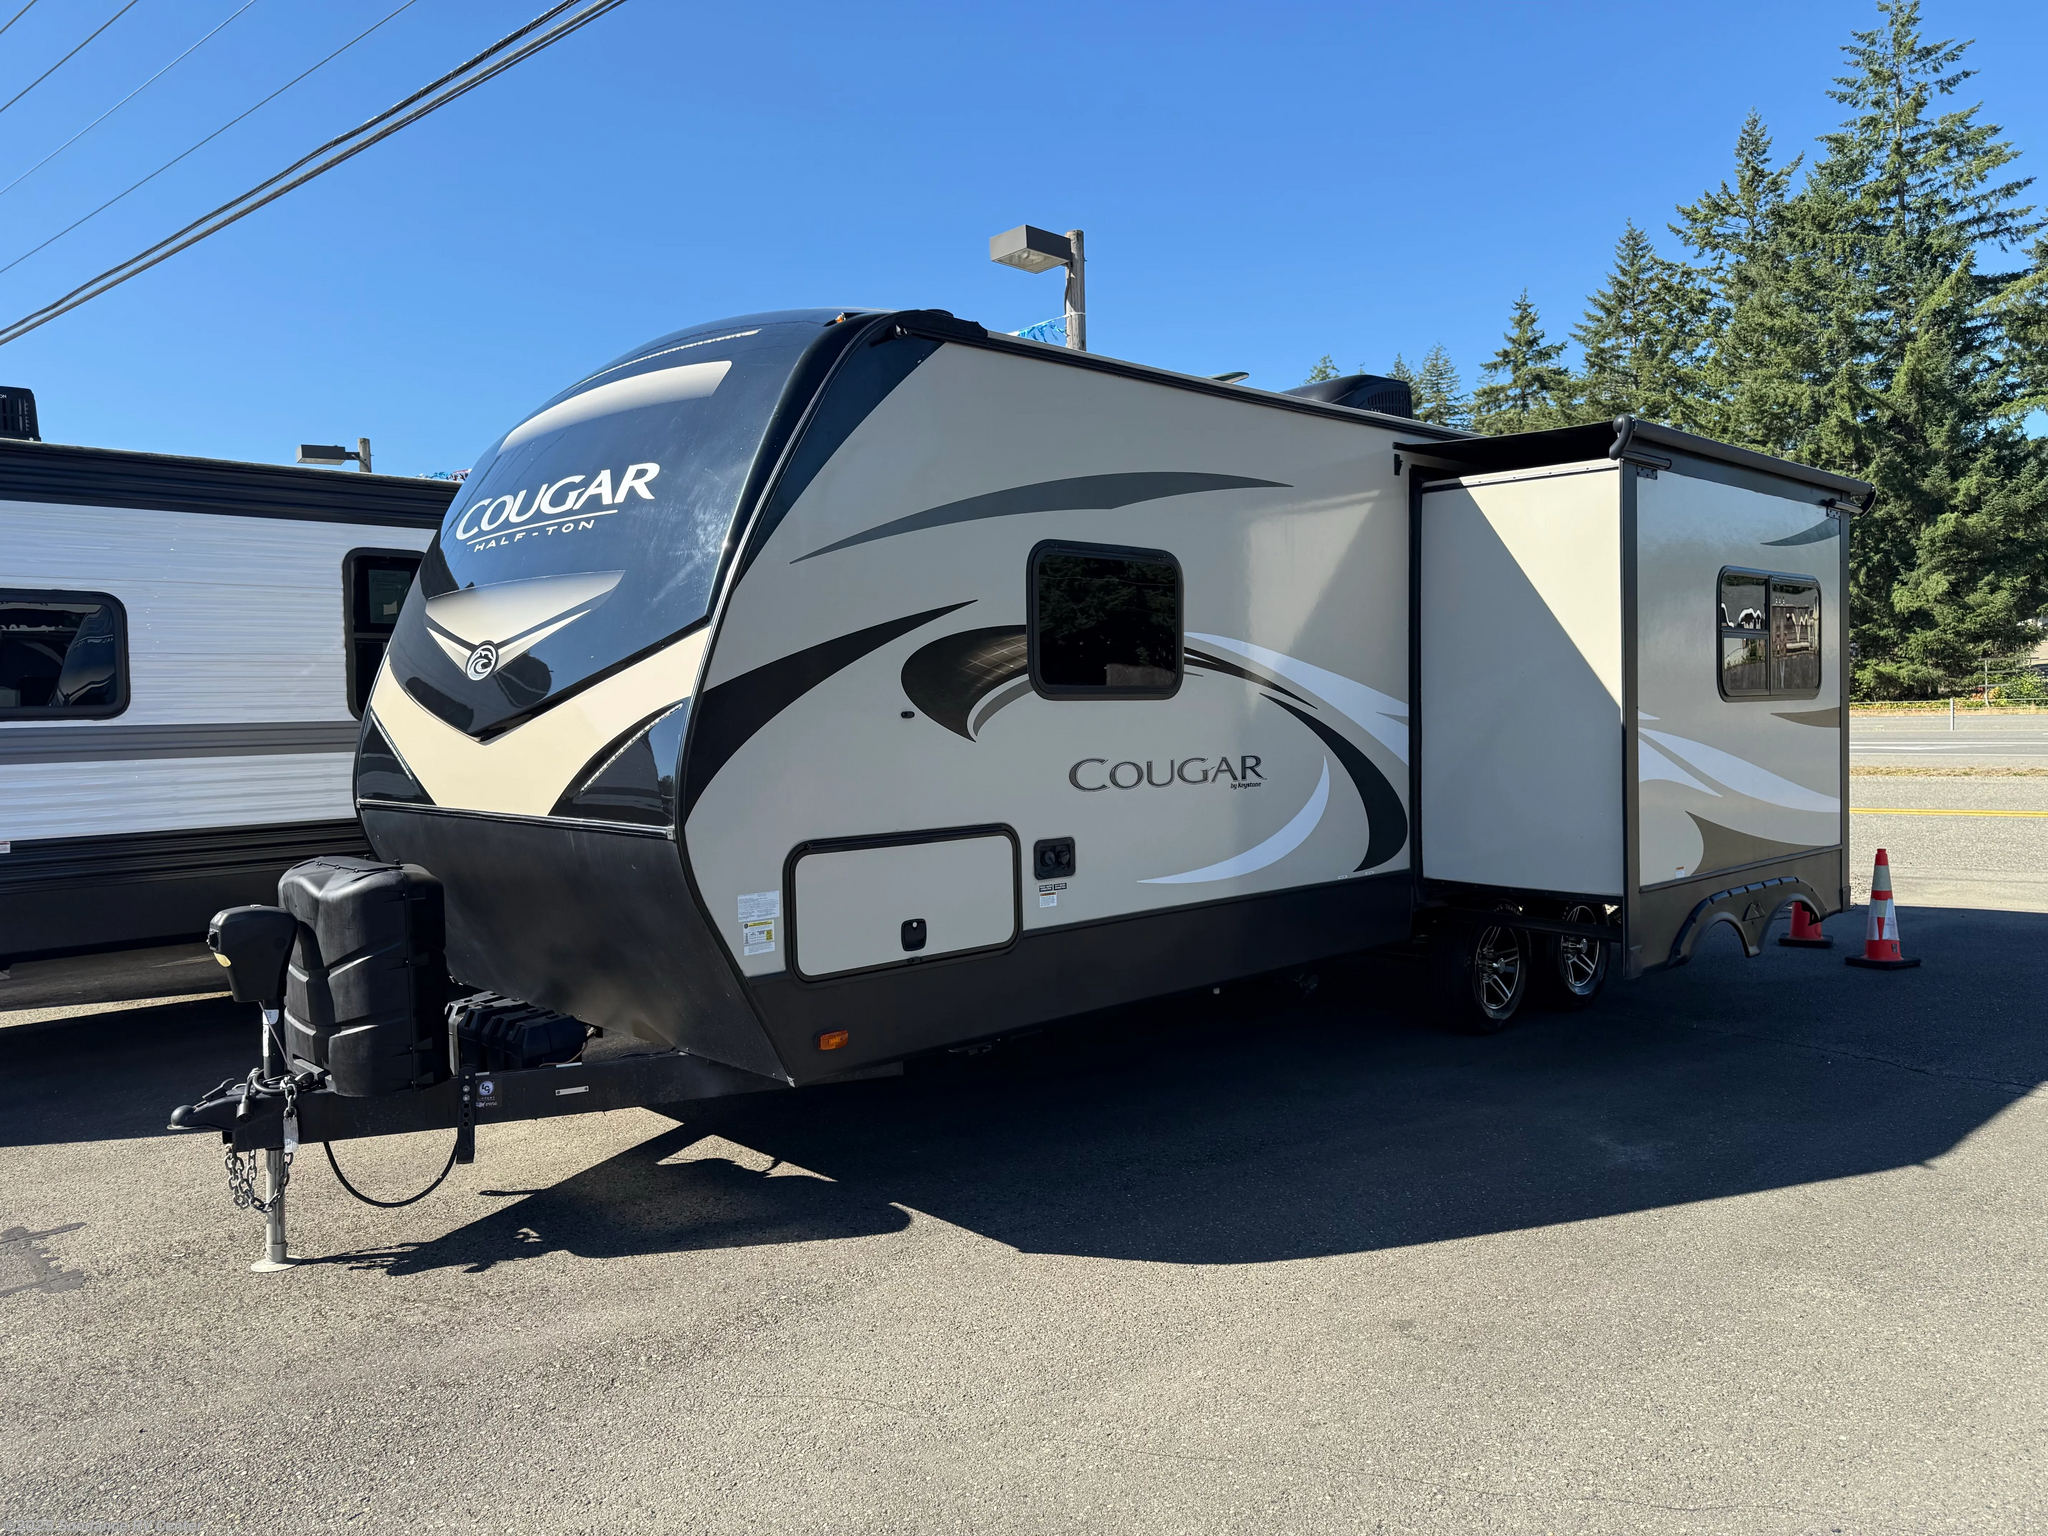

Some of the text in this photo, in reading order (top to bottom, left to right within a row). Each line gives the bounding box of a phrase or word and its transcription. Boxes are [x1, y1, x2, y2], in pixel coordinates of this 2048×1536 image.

[455, 462, 660, 540] COUGAR
[473, 519, 595, 552] HALF-TON
[1068, 754, 1266, 793] COUGAR
[1230, 781, 1262, 791] by Keystone
